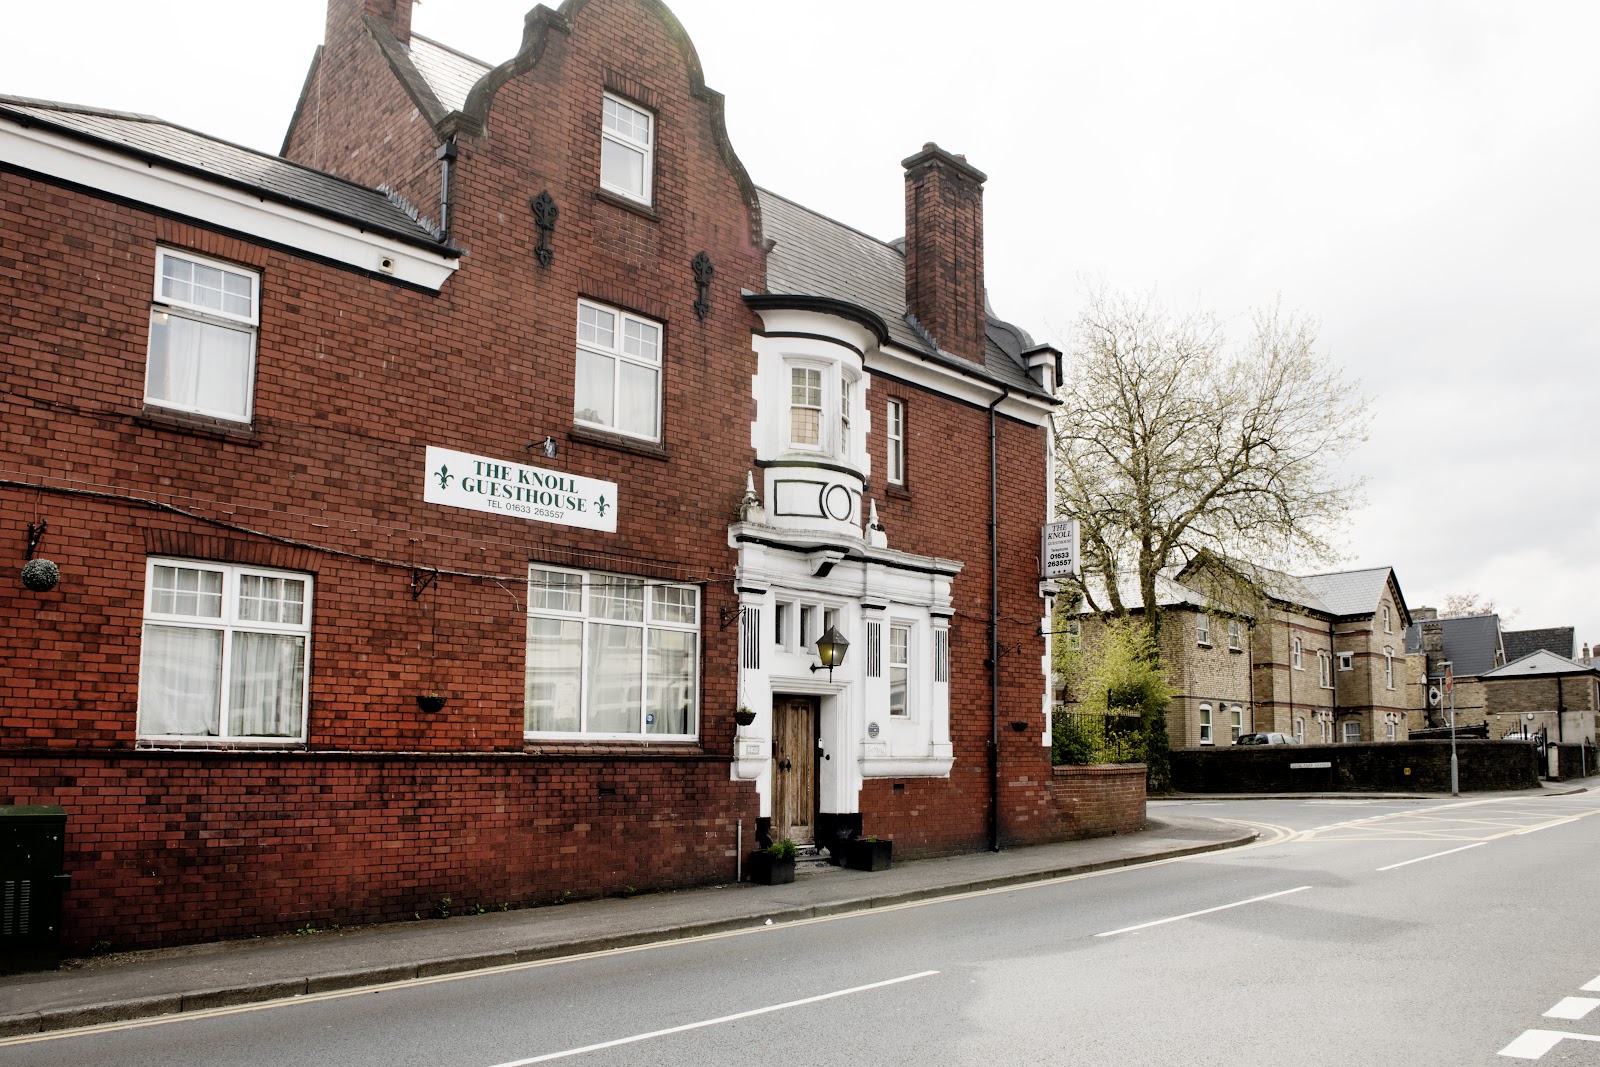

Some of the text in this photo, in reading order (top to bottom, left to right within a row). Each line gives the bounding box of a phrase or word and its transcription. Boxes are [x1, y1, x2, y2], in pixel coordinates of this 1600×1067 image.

[473, 460, 579, 494] THE KNOLL
[461, 477, 587, 512] GUESTHOUSE
[487, 499, 565, 519] TEL 01633 263557
[1048, 531, 1071, 539] KNOLL
[1048, 559, 1071, 567] 263557
[1050, 552, 1069, 560] 01633
